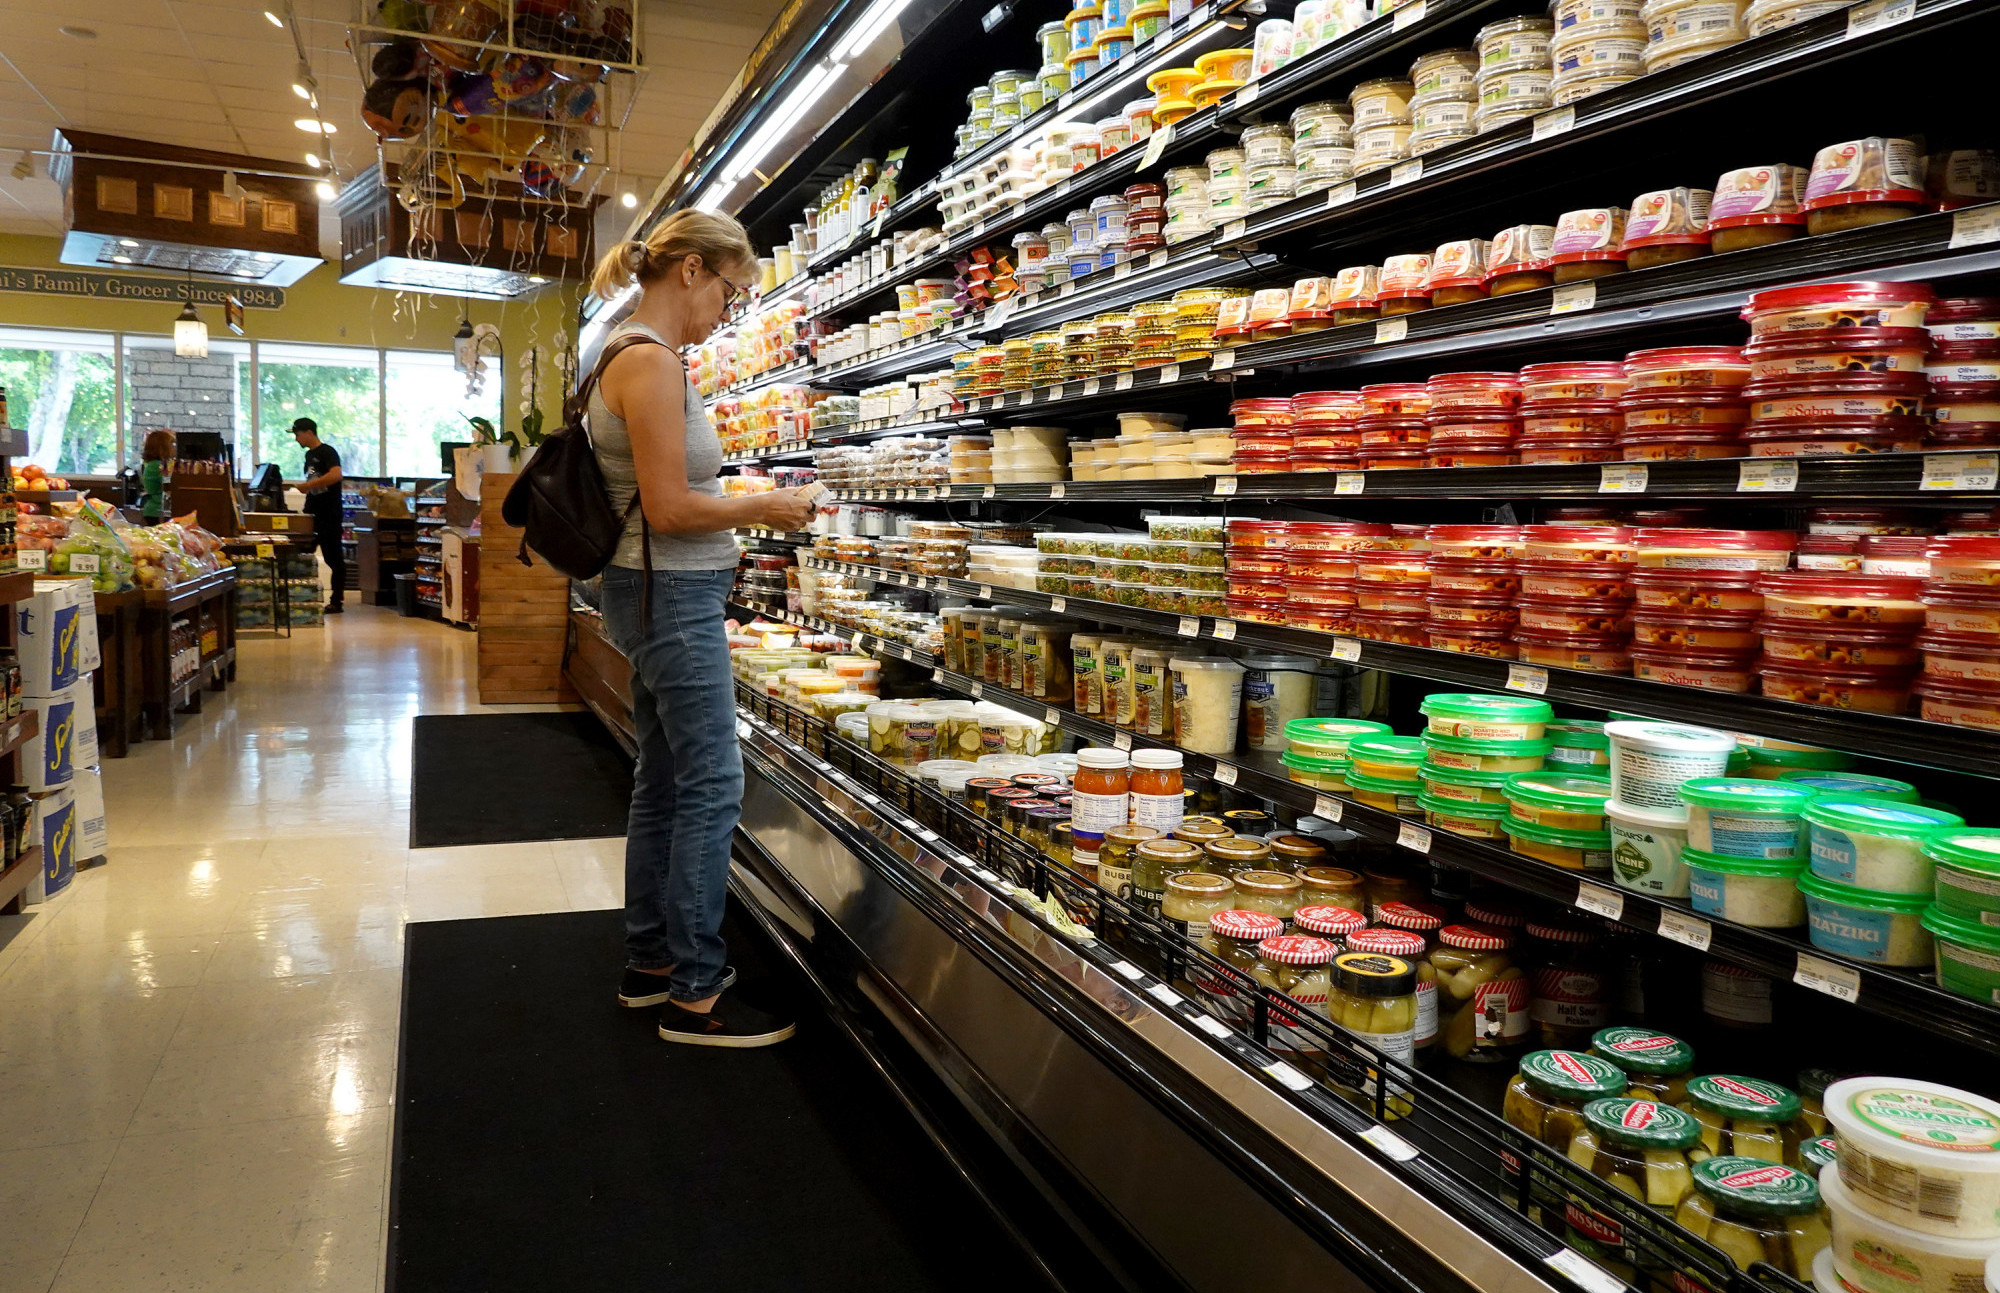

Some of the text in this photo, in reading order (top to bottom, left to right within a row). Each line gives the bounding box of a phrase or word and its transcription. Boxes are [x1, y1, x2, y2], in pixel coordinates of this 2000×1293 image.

[0, 272, 276, 306] i's Family Grocer Since 1984
[1787, 315, 1806, 323] Olive
[1787, 321, 1826, 330] Tapenade
[1954, 332, 1995, 340] Tapenade
[1795, 358, 1815, 366] Olive
[1795, 364, 1835, 373] Tapenade
[1957, 373, 1998, 381] Tapenade
[1795, 403, 1882, 416] Sabra Tapenade
[1773, 477, 1791, 486] $5.29
[1966, 476, 1989, 486] $5.29
[1552, 552, 1579, 560] Classic
[1815, 561, 1842, 569] Classic
[1950, 571, 1984, 582] Classic
[1553, 586, 1583, 594] Classic
[1783, 607, 1814, 616] Classic
[1954, 619, 1993, 629] Classic
[1668, 672, 1703, 686] Sabra
[1613, 825, 1643, 842] CEDAR'S
[1616, 853, 1645, 869] LABNE
[1105, 869, 1131, 881] BUBB
[1134, 886, 1163, 900] BUBB
[1829, 980, 1849, 997] $6.99
[1557, 1003, 1598, 1017] Half Sour
[1868, 1104, 1988, 1127] ROMANO
